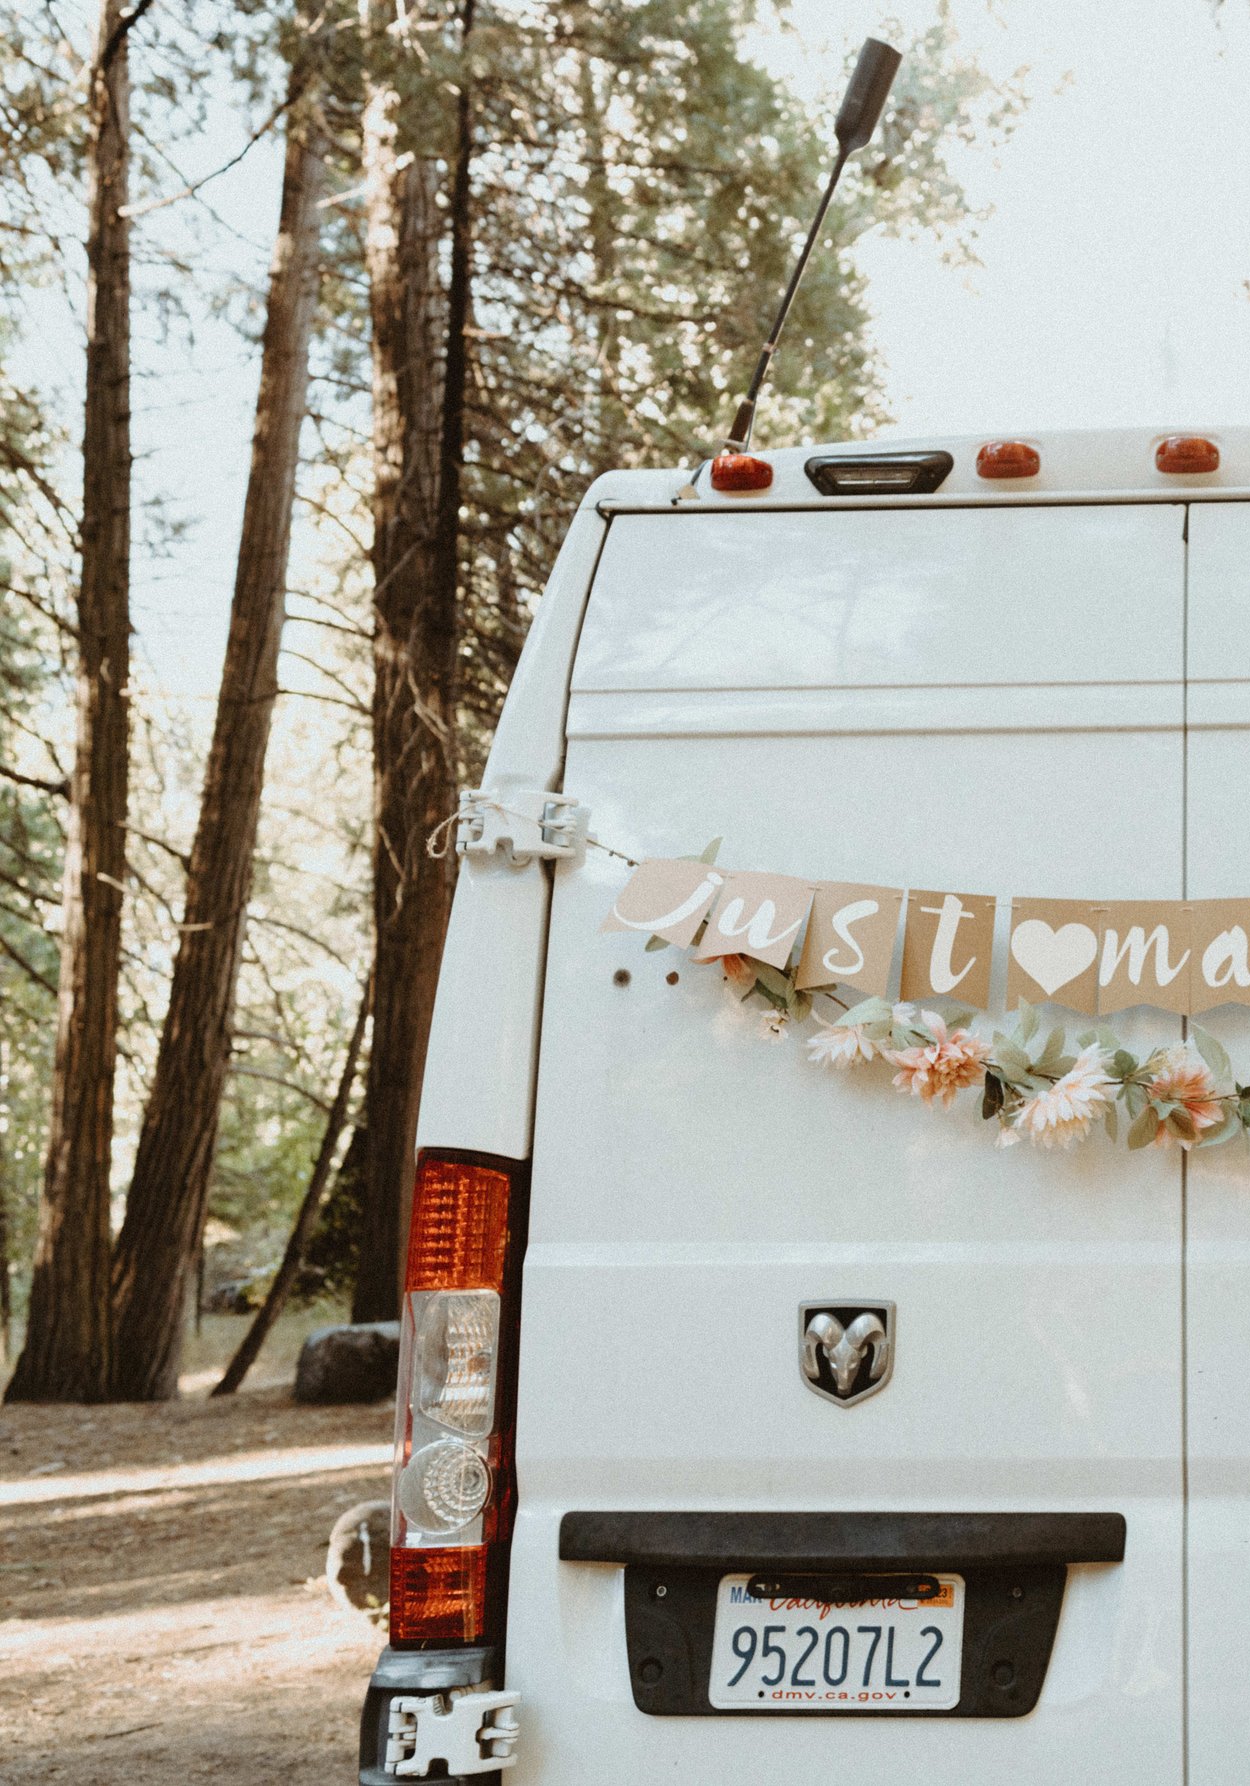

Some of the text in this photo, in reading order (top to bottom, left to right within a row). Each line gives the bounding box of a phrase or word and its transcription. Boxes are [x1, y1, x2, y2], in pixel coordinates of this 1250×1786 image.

[613, 871, 976, 994] just
[727, 1625, 943, 1687] 95207L2
[772, 1689, 897, 1702] dmv.ca.gov
